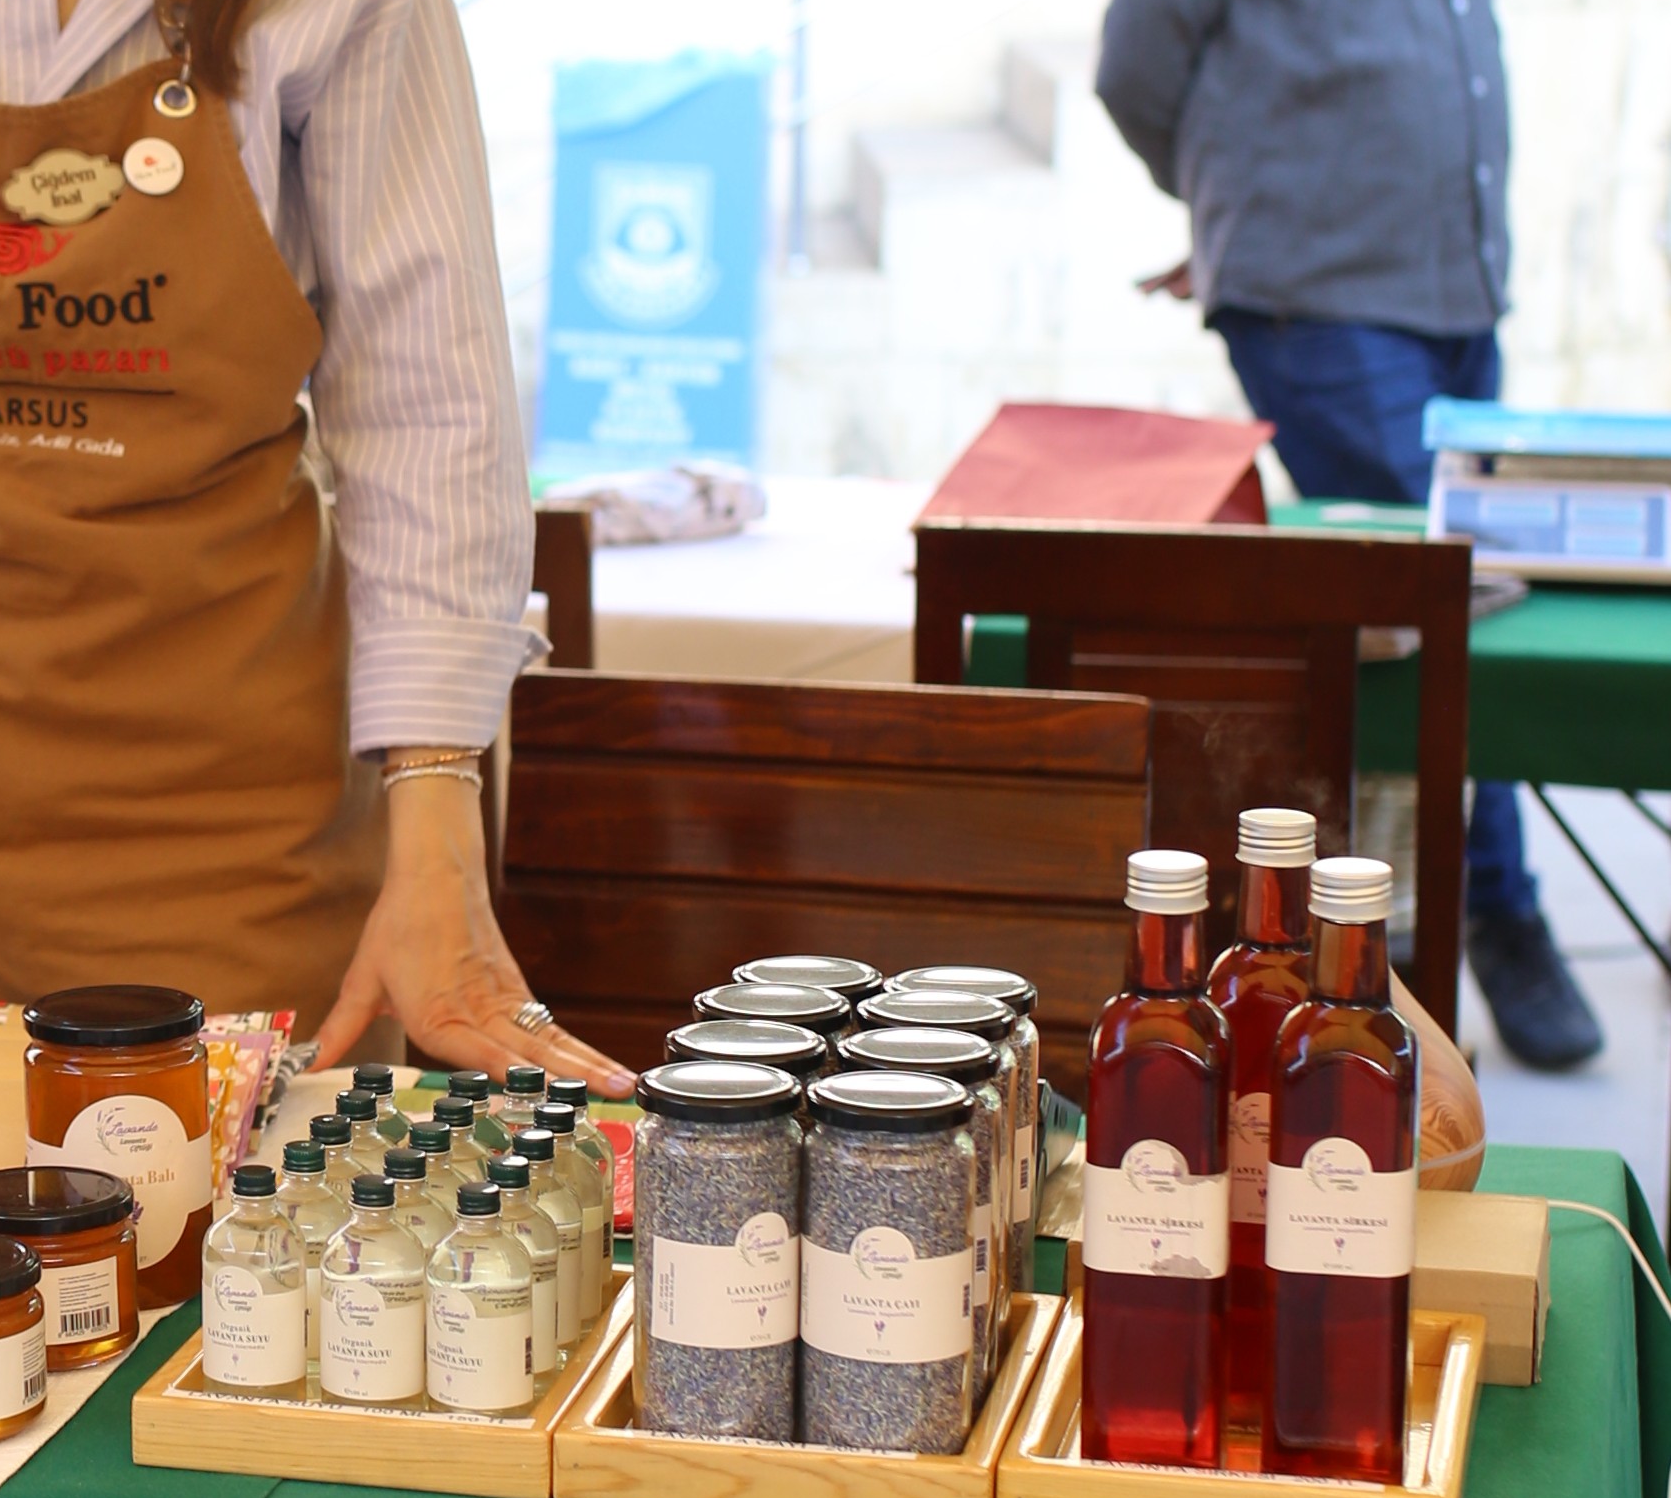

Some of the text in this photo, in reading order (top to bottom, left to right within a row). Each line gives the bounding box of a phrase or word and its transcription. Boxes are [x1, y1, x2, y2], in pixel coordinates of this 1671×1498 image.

[147, 1169, 175, 1185] Balı
[246, 1335, 270, 1343] SUYU
[368, 1349, 392, 1358] SUYU
